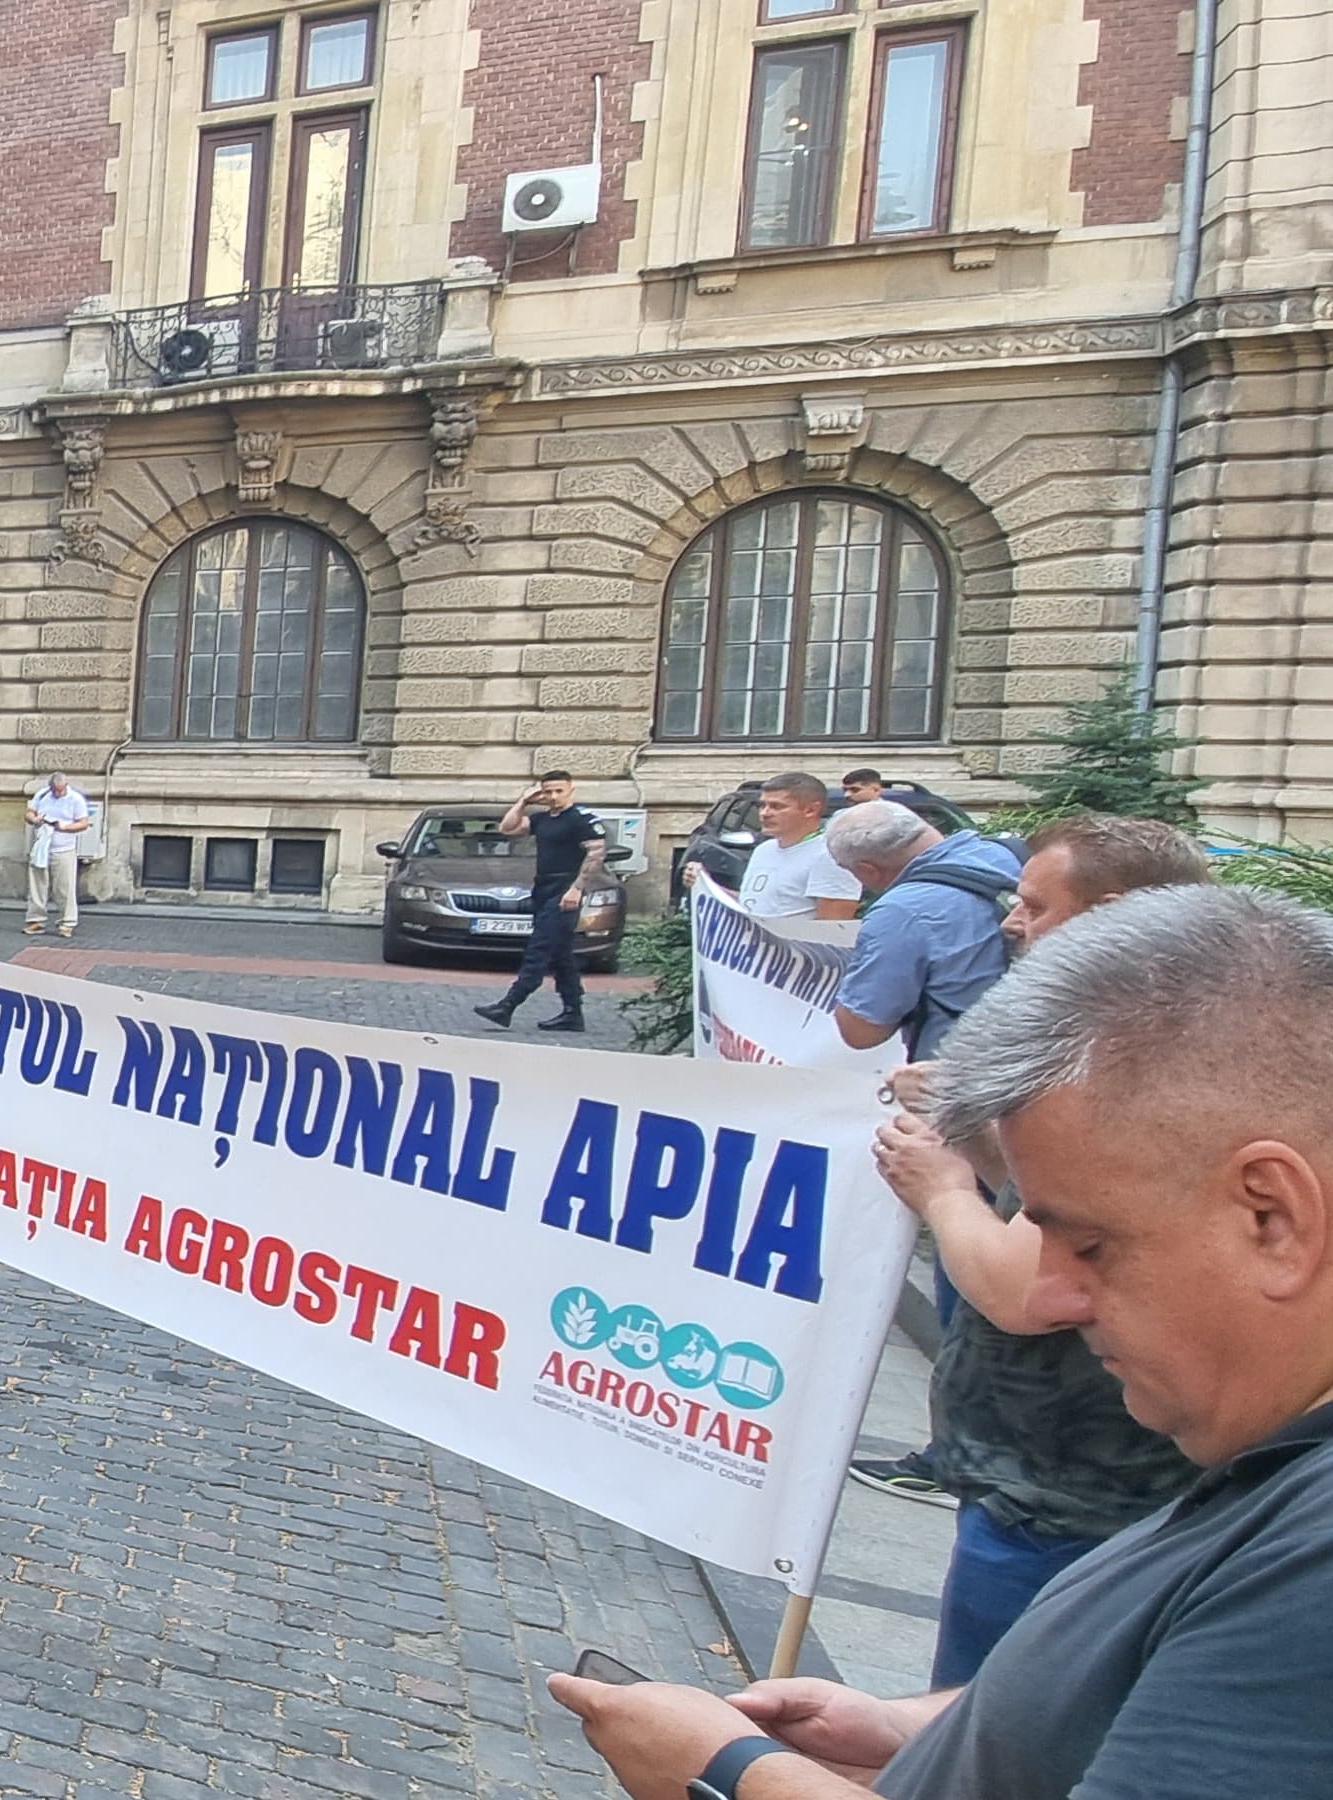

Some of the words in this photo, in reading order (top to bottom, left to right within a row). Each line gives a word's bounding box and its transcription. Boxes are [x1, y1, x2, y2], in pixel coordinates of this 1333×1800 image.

[479, 920, 487, 930] B
[491, 920, 514, 931] 239
[112, 1016, 516, 1211] NAȚIONAL
[541, 1099, 829, 1302] APIA
[124, 1195, 506, 1391] AGROSTAR
[538, 1350, 774, 1464] AGROSTAR
[704, 1449, 765, 1477] AGRICULTURA
[719, 1467, 765, 1490] CONEXE
